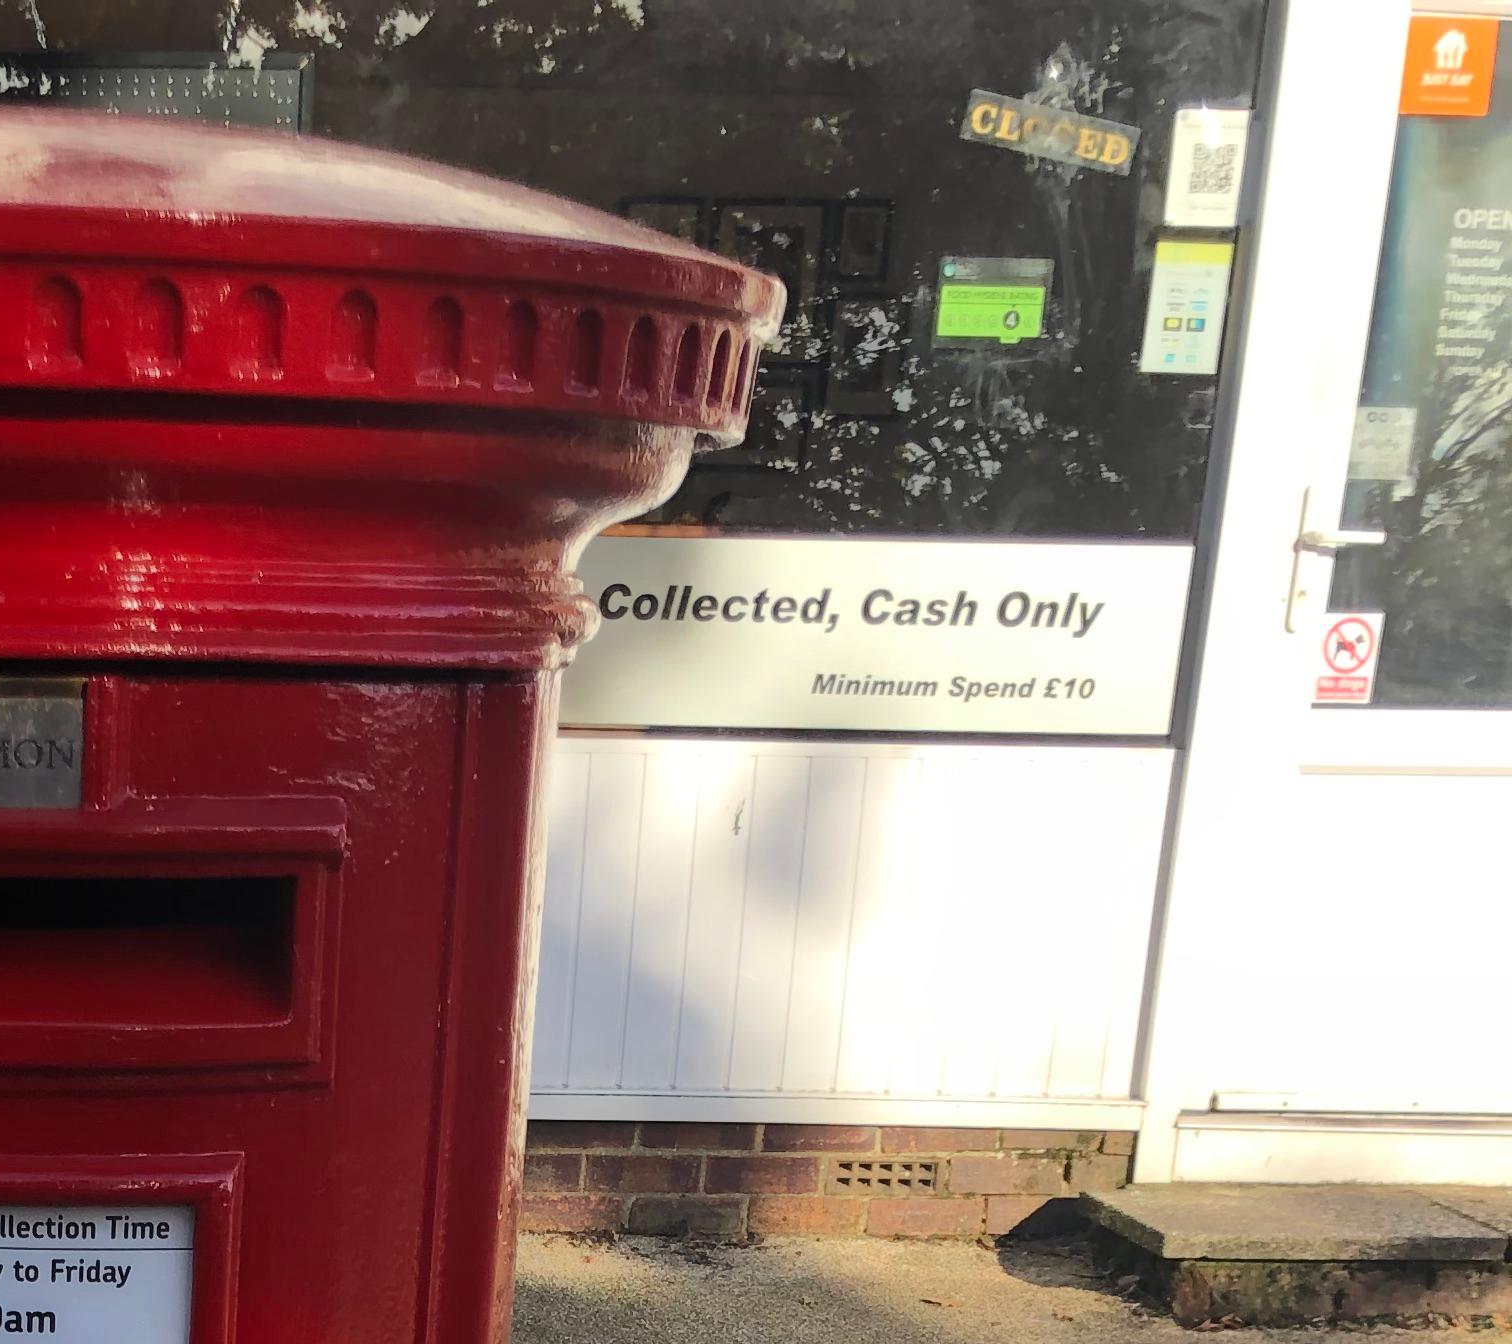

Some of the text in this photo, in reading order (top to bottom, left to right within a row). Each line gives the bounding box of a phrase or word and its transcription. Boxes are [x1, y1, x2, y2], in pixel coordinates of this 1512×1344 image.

[1449, 236, 1503, 253] Monday
[1005, 311, 1017, 328] 4
[598, 584, 1105, 638] Collected, Cash Only
[811, 673, 1097, 702] Minimum Spend £10
[105, 1215, 170, 1241] Time
[13, 1260, 39, 1283] to
[51, 1259, 131, 1288] Friday
